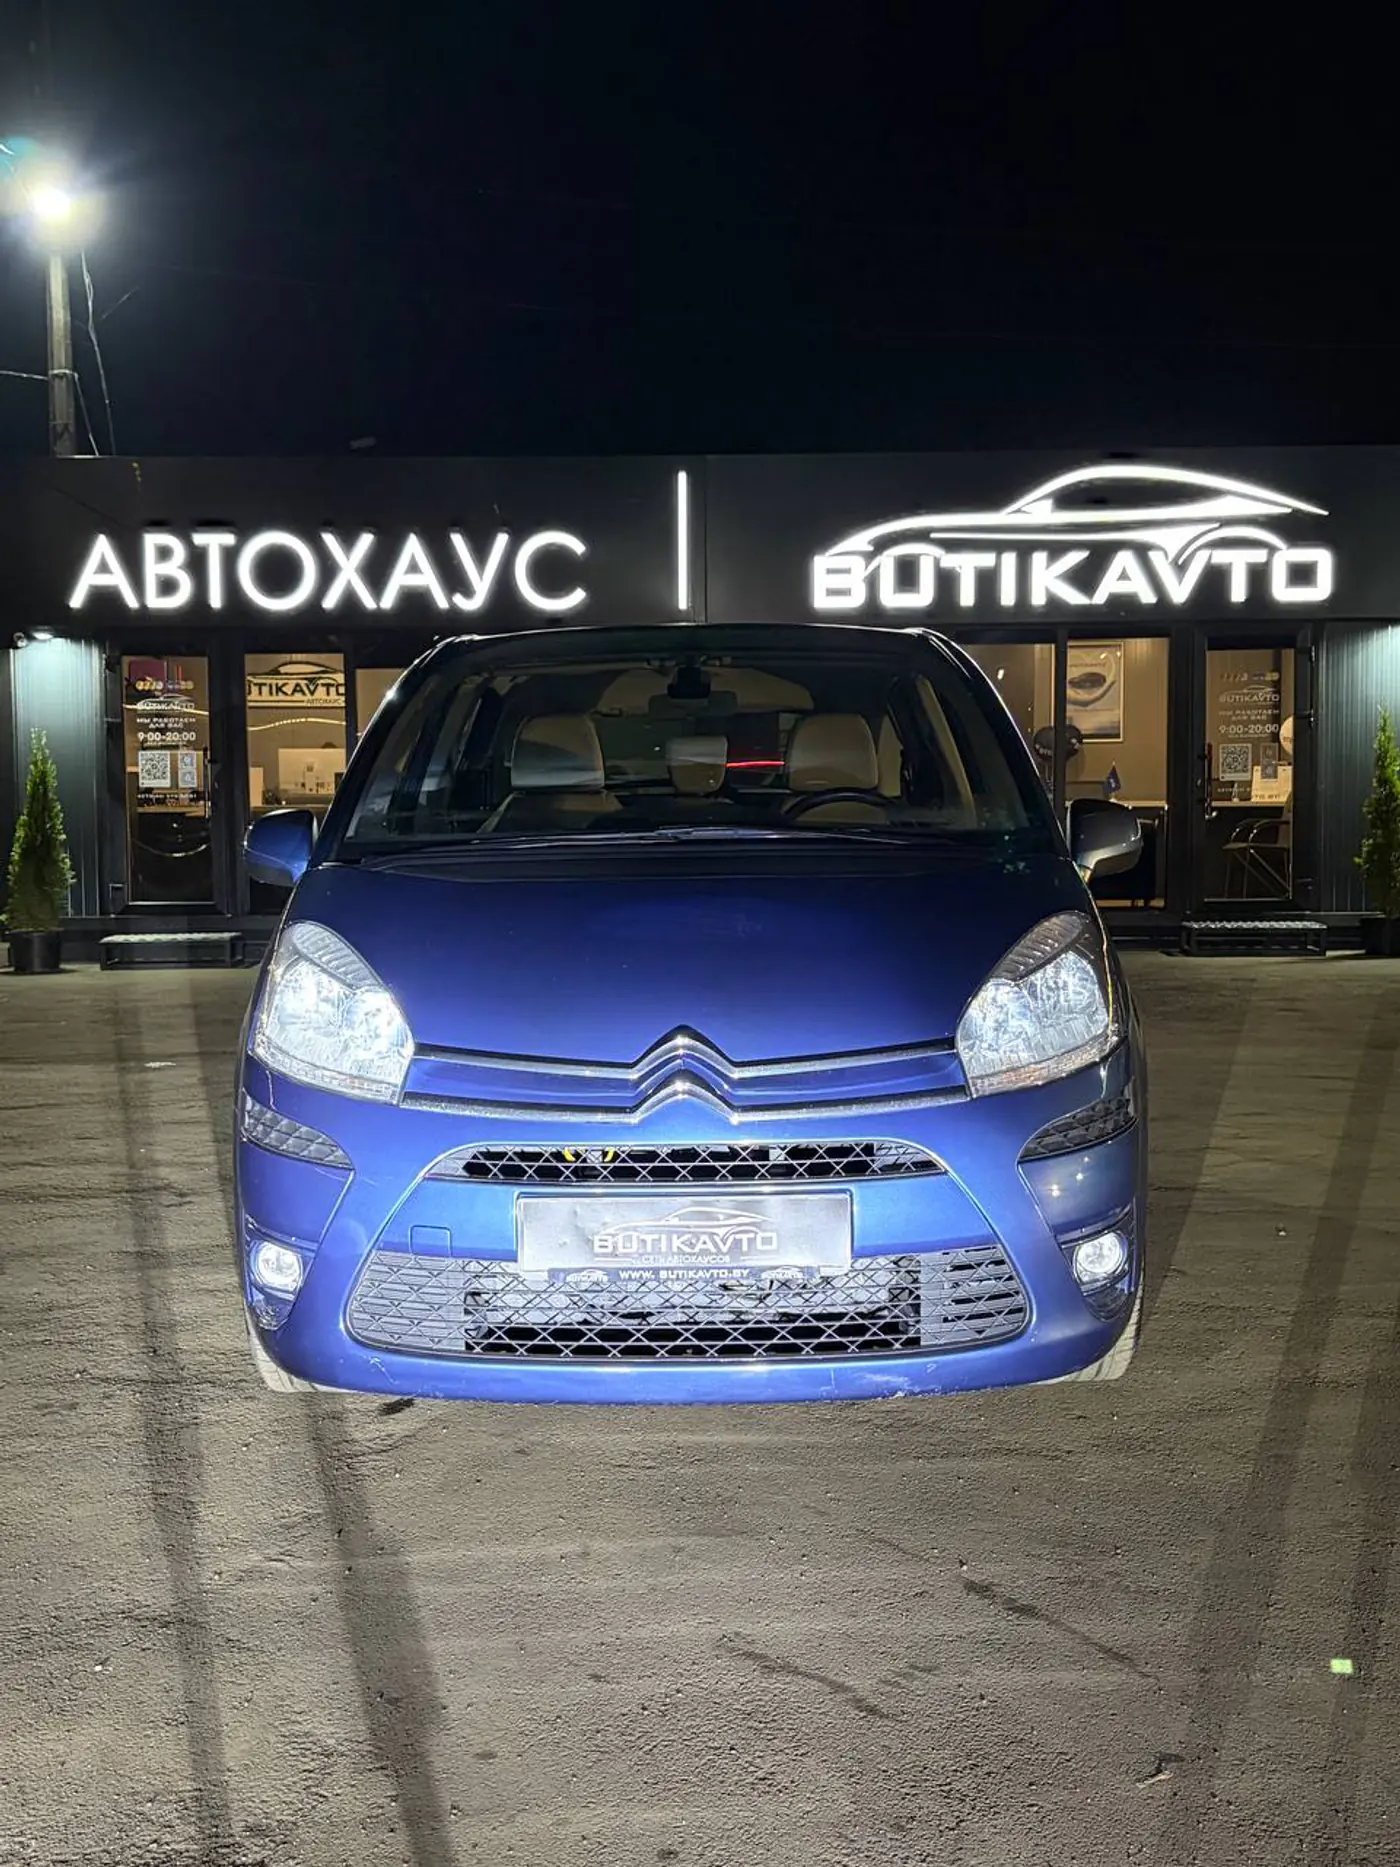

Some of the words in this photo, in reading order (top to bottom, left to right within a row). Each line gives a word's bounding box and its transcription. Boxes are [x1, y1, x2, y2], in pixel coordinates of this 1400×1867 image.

[68, 529, 588, 612] АВТОХАУС
[811, 547, 1334, 609] BUTIKAVTO
[1219, 693, 1280, 702] BUTIKAVTO
[137, 731, 197, 742] 9:00-20:00
[1218, 723, 1279, 734] 9:00-20:00
[593, 1232, 778, 1254] BUTIKAVTO
